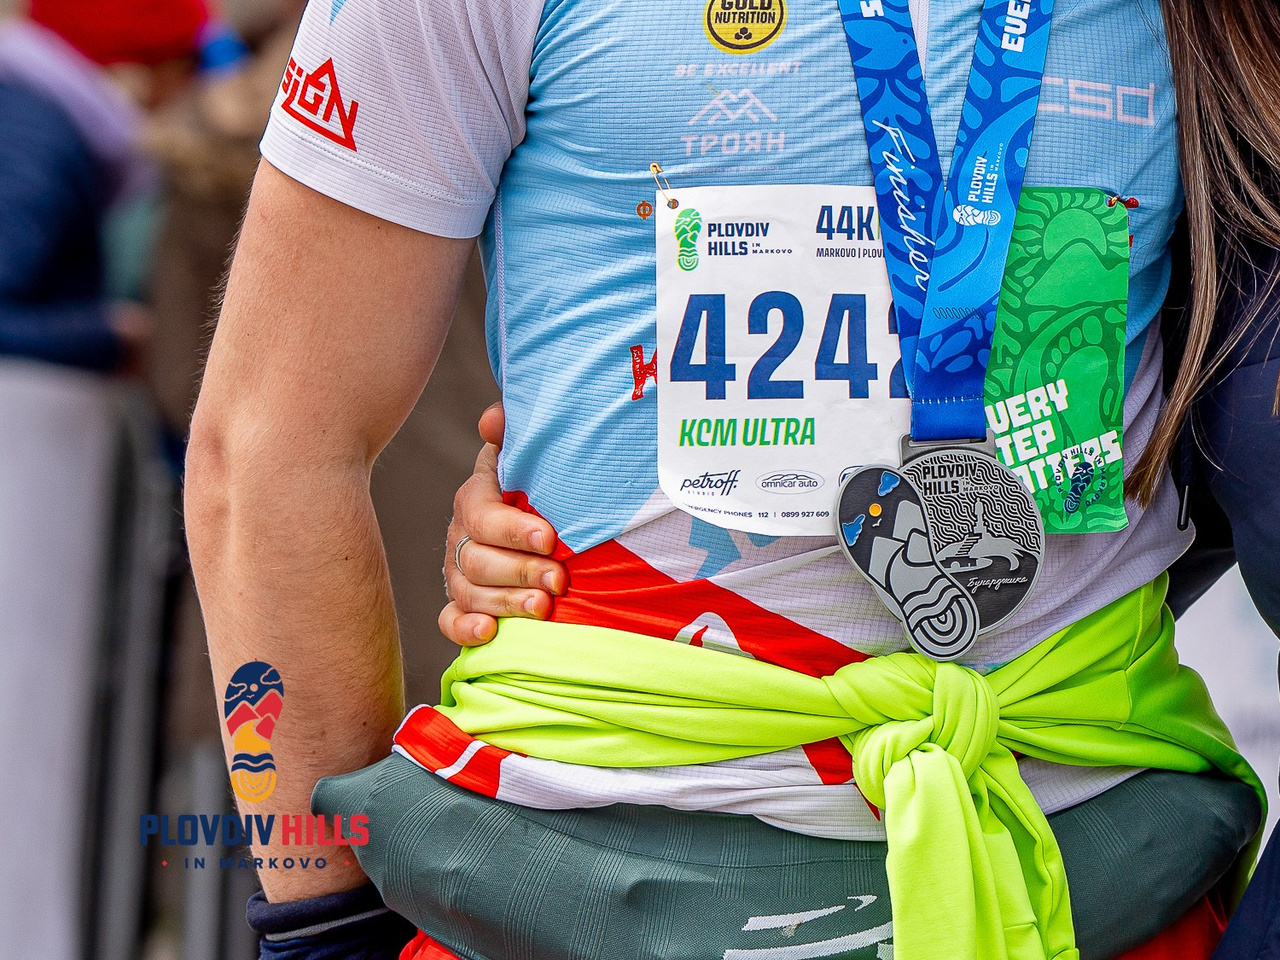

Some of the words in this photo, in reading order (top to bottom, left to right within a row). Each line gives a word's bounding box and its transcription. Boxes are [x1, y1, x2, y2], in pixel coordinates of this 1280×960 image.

[714, 11, 776, 24] NUTRITION
[675, 63, 697, 77] BE
[703, 61, 802, 77] EXCELLENT
[680, 131, 786, 156] ТРОЯН
[968, 155, 988, 202] PLOVDIV
[982, 172, 998, 204] HILLS
[872, 119, 936, 292] Finisher
[707, 222, 770, 237] PLOVDIV
[707, 241, 748, 256] HILLS
[815, 247, 857, 258] MARKOVO
[862, 248, 886, 259] PLOV
[985, 378, 1069, 435] VERY
[678, 418, 738, 447] KCM
[742, 417, 816, 446] ULTRA
[994, 419, 1057, 467] TEP
[1070, 447, 1095, 457] HILLS
[922, 462, 978, 480] PLOVDIV
[761, 479, 796, 489] omnicar
[798, 479, 819, 489] auto
[923, 480, 960, 496] HILLS
[962, 484, 999, 492] MARKOVO
[723, 509, 753, 518] PHONES
[815, 510, 830, 518] 609
